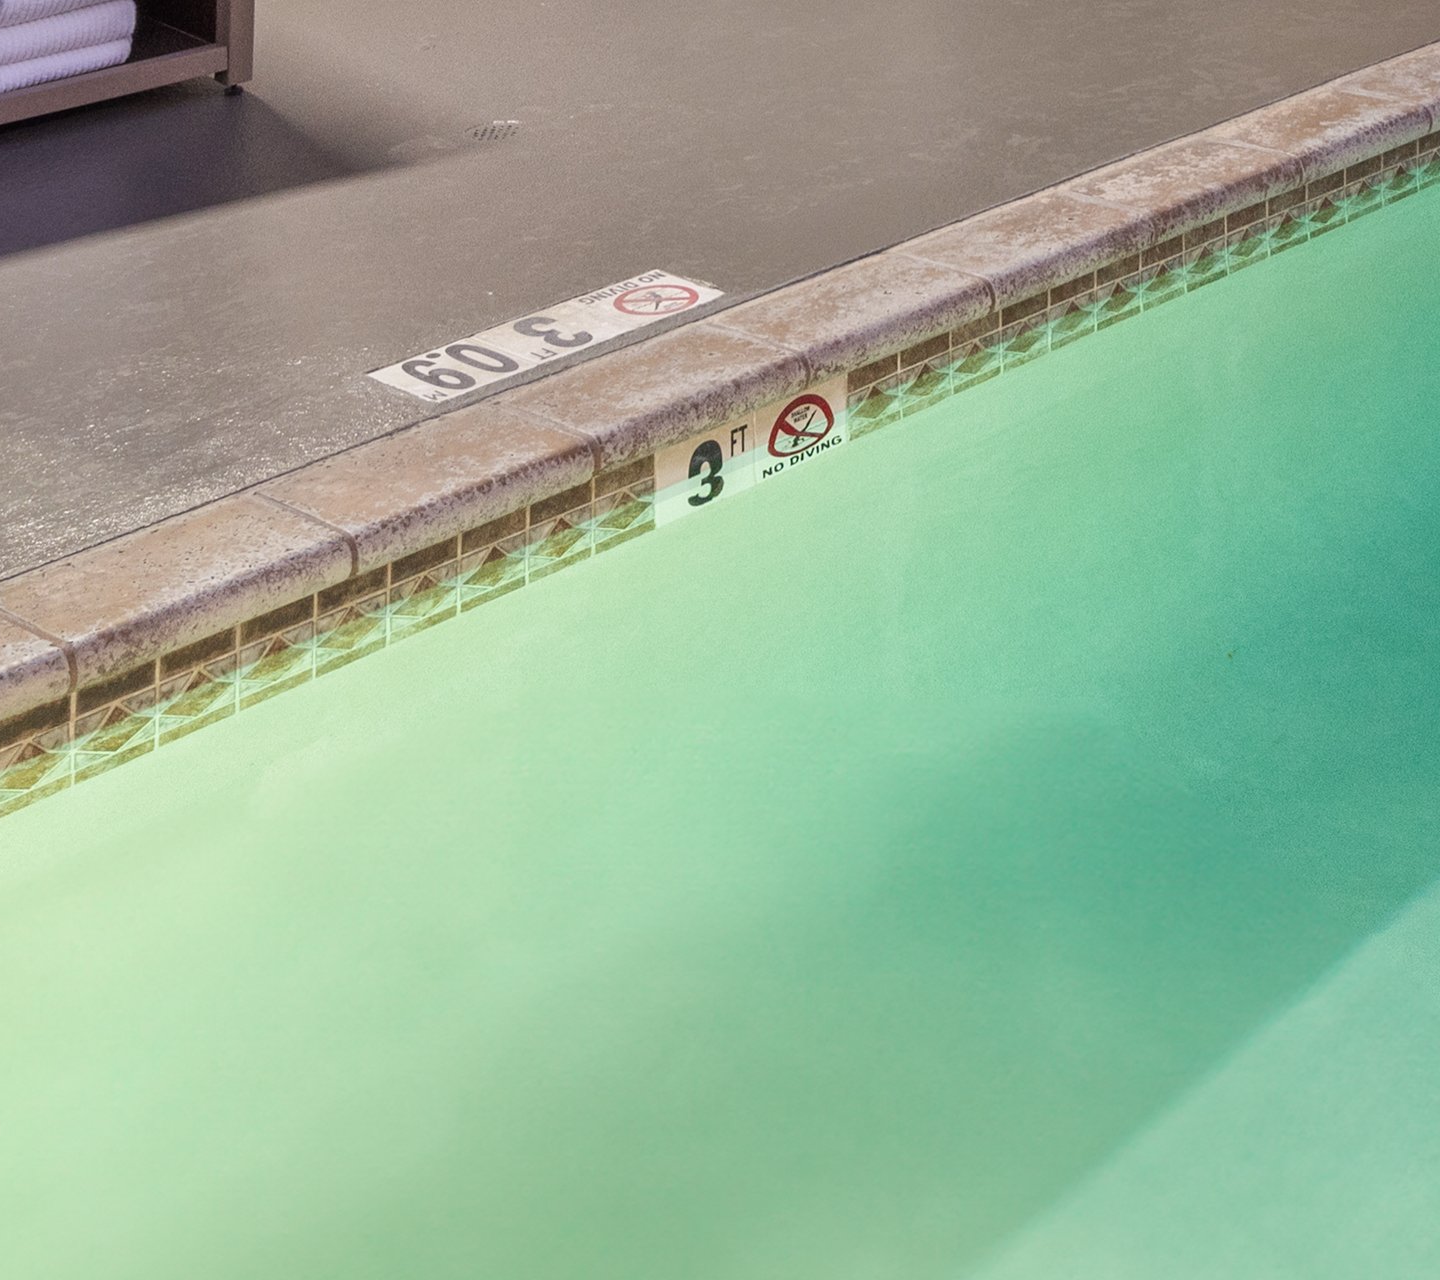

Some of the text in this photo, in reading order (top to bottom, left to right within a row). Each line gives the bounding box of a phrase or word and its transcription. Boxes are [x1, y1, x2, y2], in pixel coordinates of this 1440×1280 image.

[577, 271, 665, 306] NO DIVING
[513, 316, 593, 361] 3 FT
[402, 344, 520, 402] 0.9 M
[688, 423, 748, 507] 3 FT
[762, 435, 842, 479] NO DIVING
